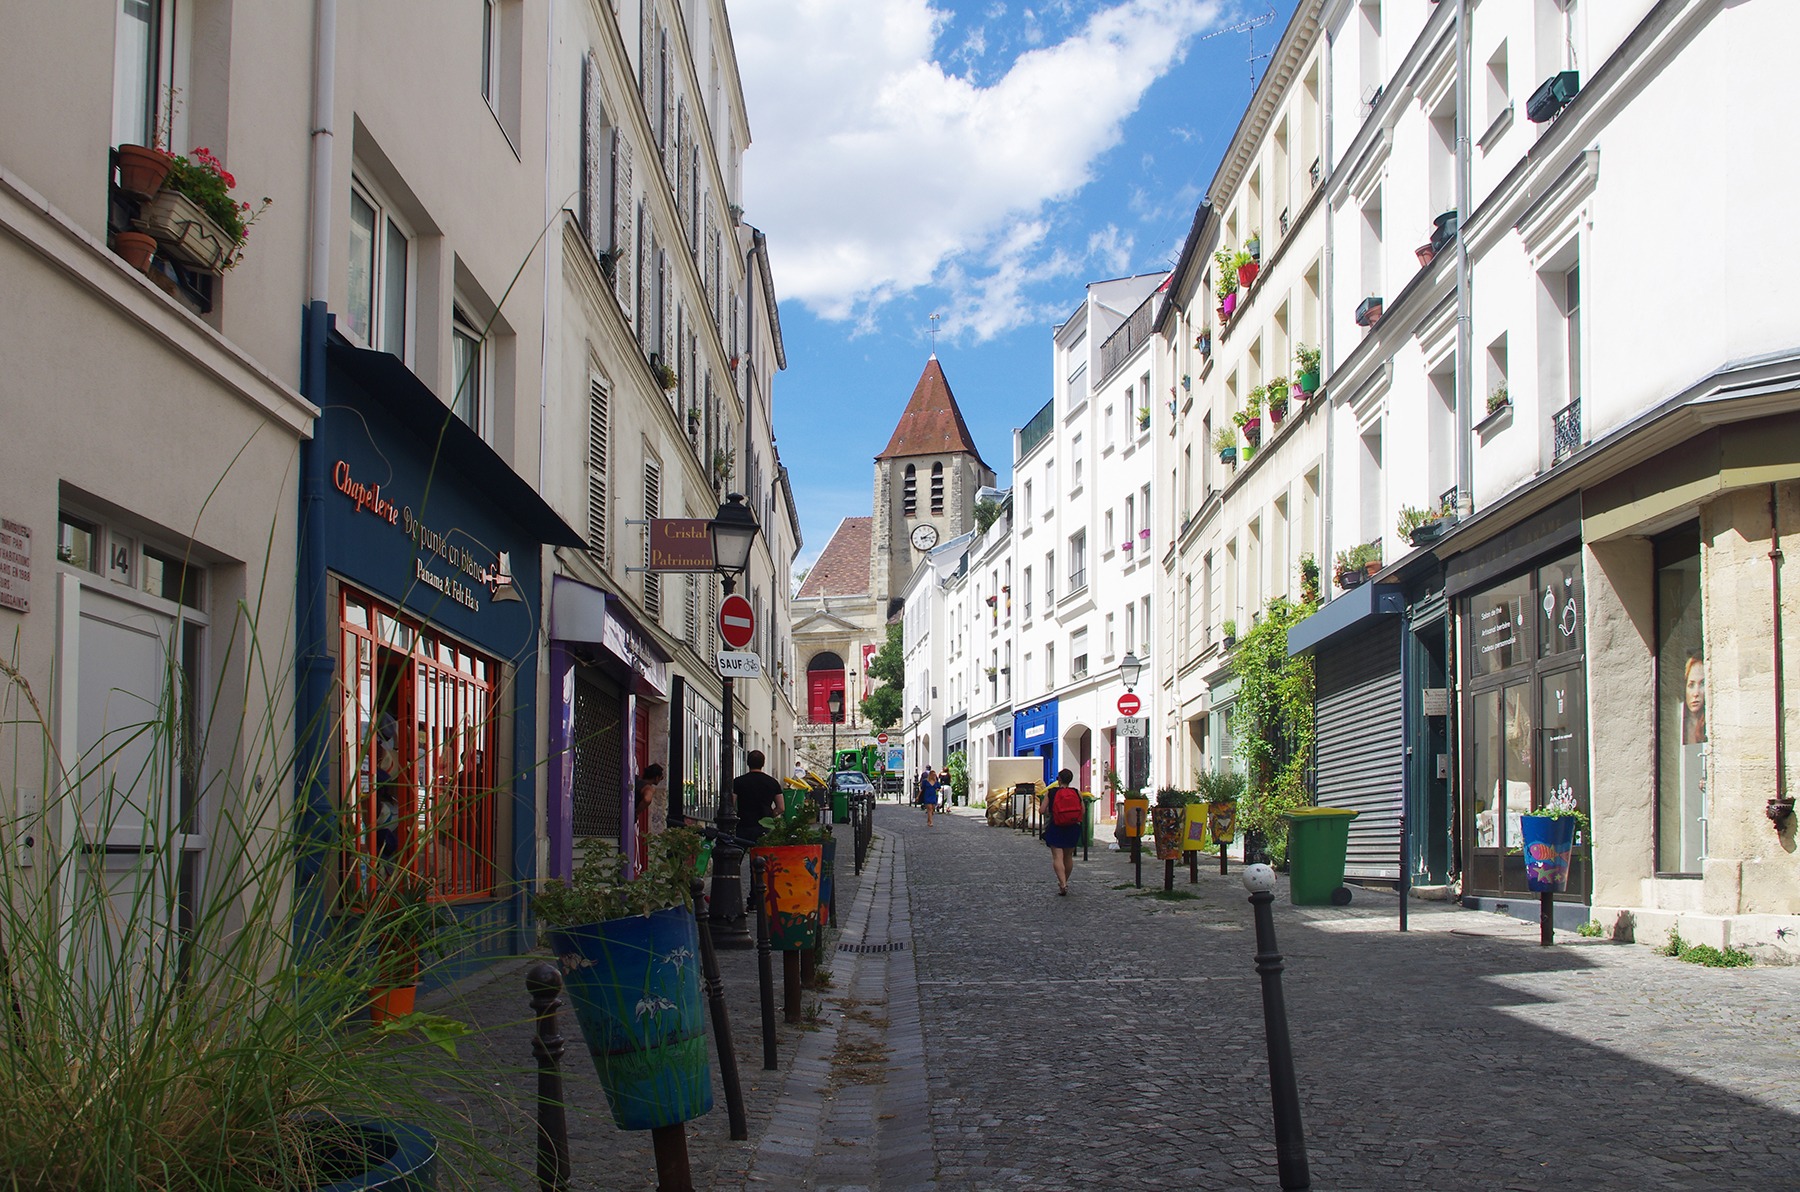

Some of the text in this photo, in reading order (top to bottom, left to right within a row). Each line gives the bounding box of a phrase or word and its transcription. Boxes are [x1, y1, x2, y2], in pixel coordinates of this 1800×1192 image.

[332, 459, 399, 525] Chapellerie
[664, 522, 707, 539] Cristal
[111, 543, 128, 574] 14
[652, 549, 713, 566] Patrimoin
[416, 558, 443, 592] Panama
[444, 577, 452, 596] &
[452, 580, 464, 604] Felt
[719, 658, 742, 669] SAUF
